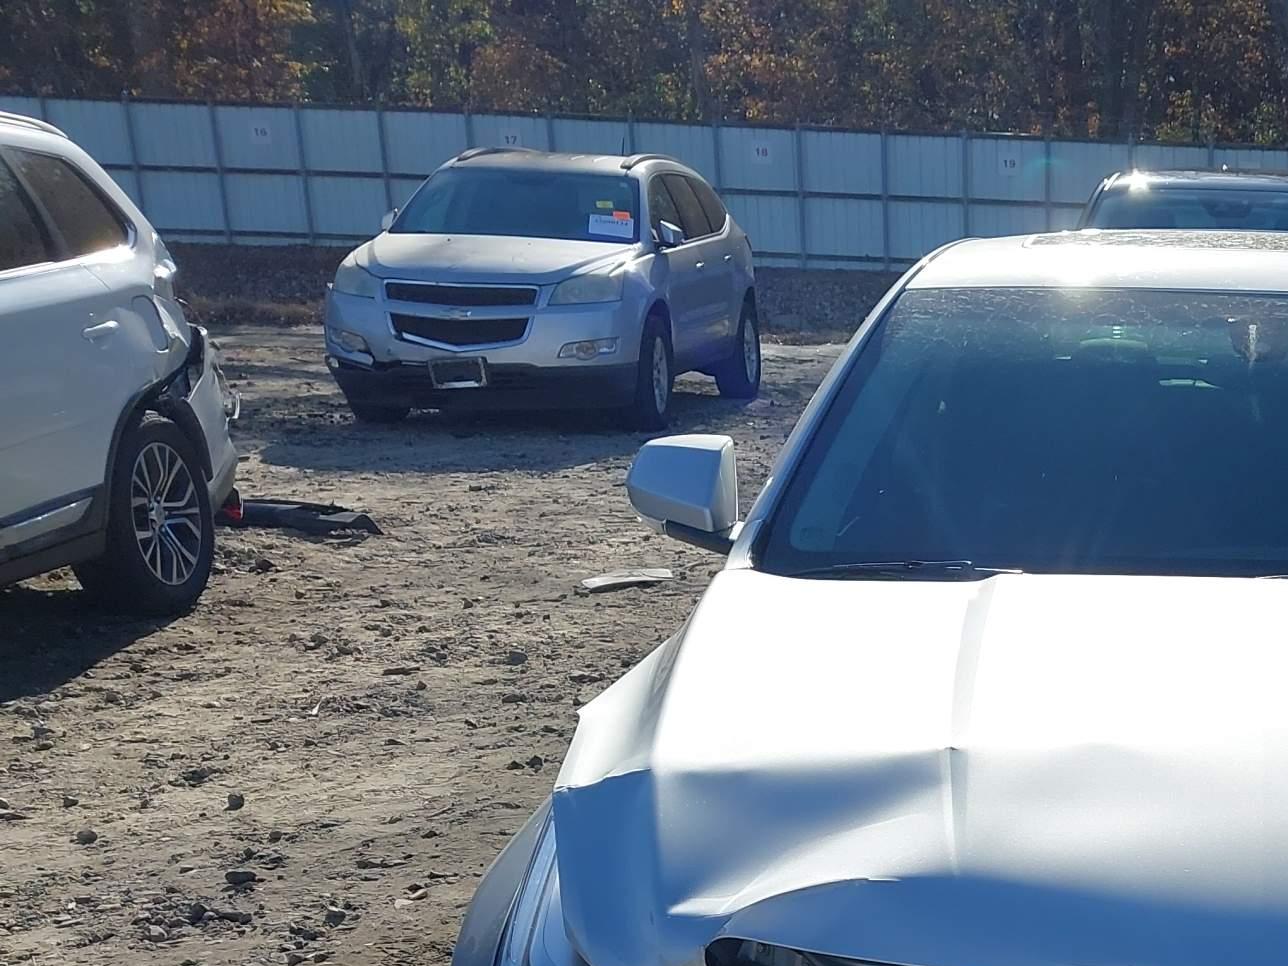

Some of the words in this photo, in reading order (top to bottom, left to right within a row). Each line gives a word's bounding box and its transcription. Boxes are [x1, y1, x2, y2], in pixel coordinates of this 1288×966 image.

[254, 127, 268, 137] 16
[504, 135, 517, 145] 17
[1003, 159, 1016, 169] 19
